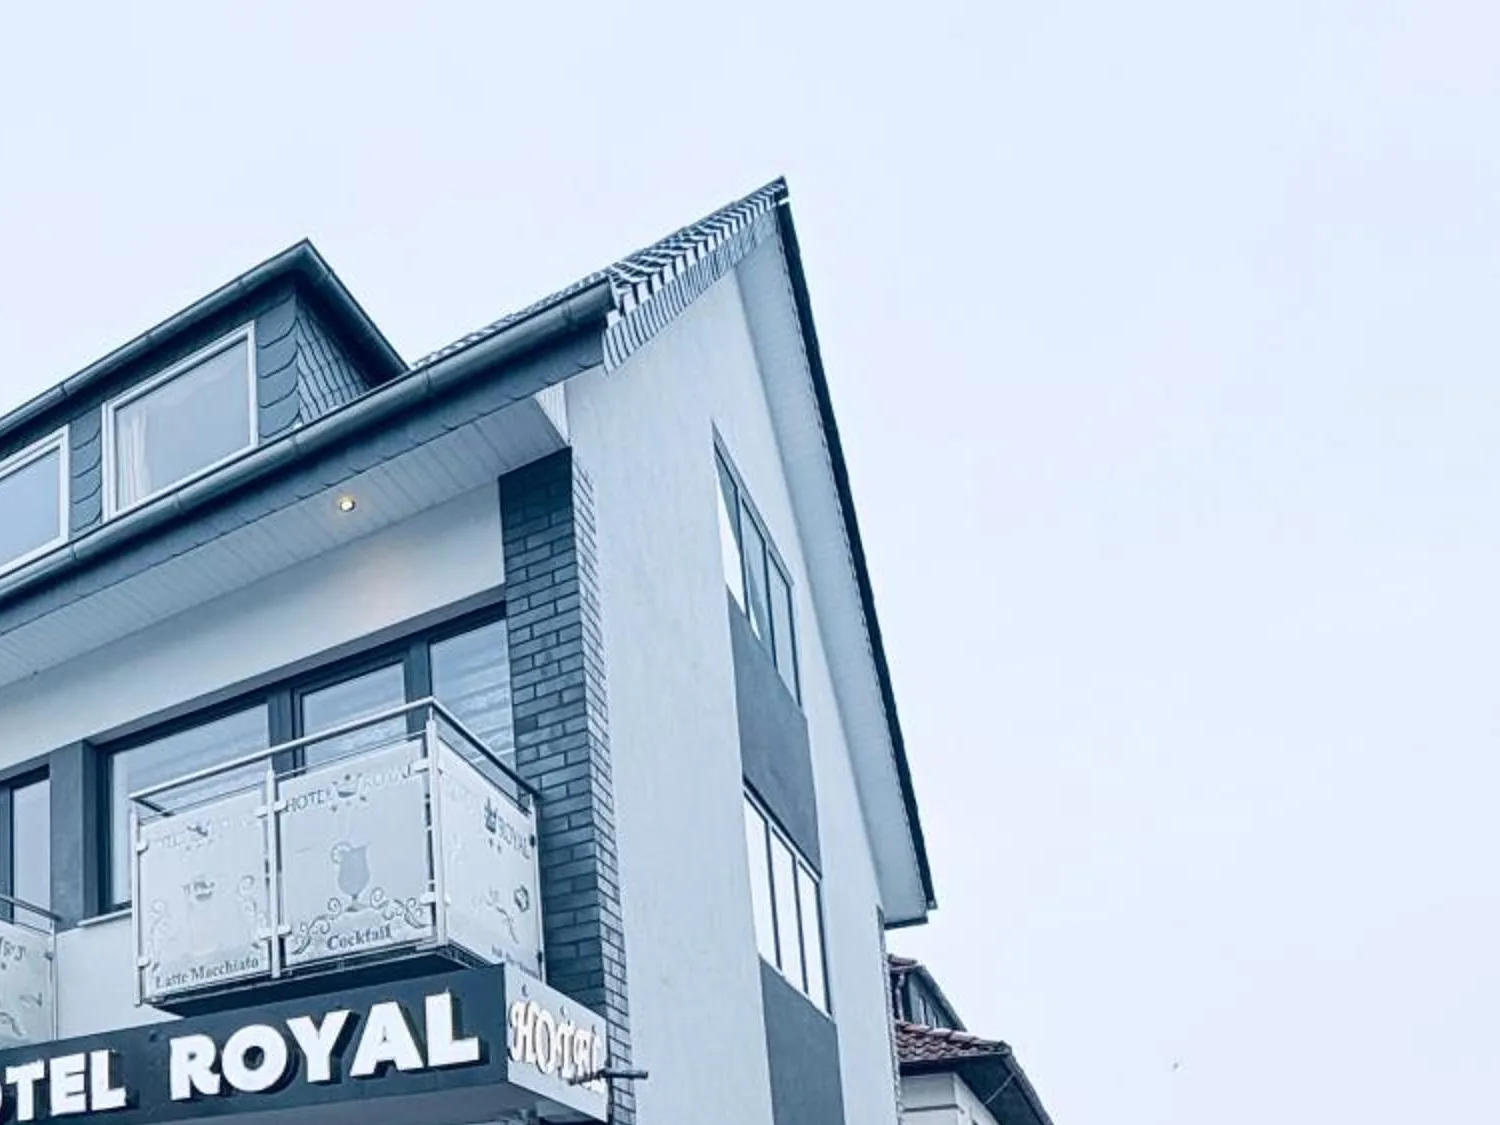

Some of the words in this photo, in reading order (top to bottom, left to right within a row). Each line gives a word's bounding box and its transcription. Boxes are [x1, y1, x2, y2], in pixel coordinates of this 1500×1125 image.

[327, 925, 393, 950] Cocktail
[155, 967, 188, 989] Latte
[169, 991, 481, 1101] ROYAL
[510, 1000, 609, 1094] HOTEL
